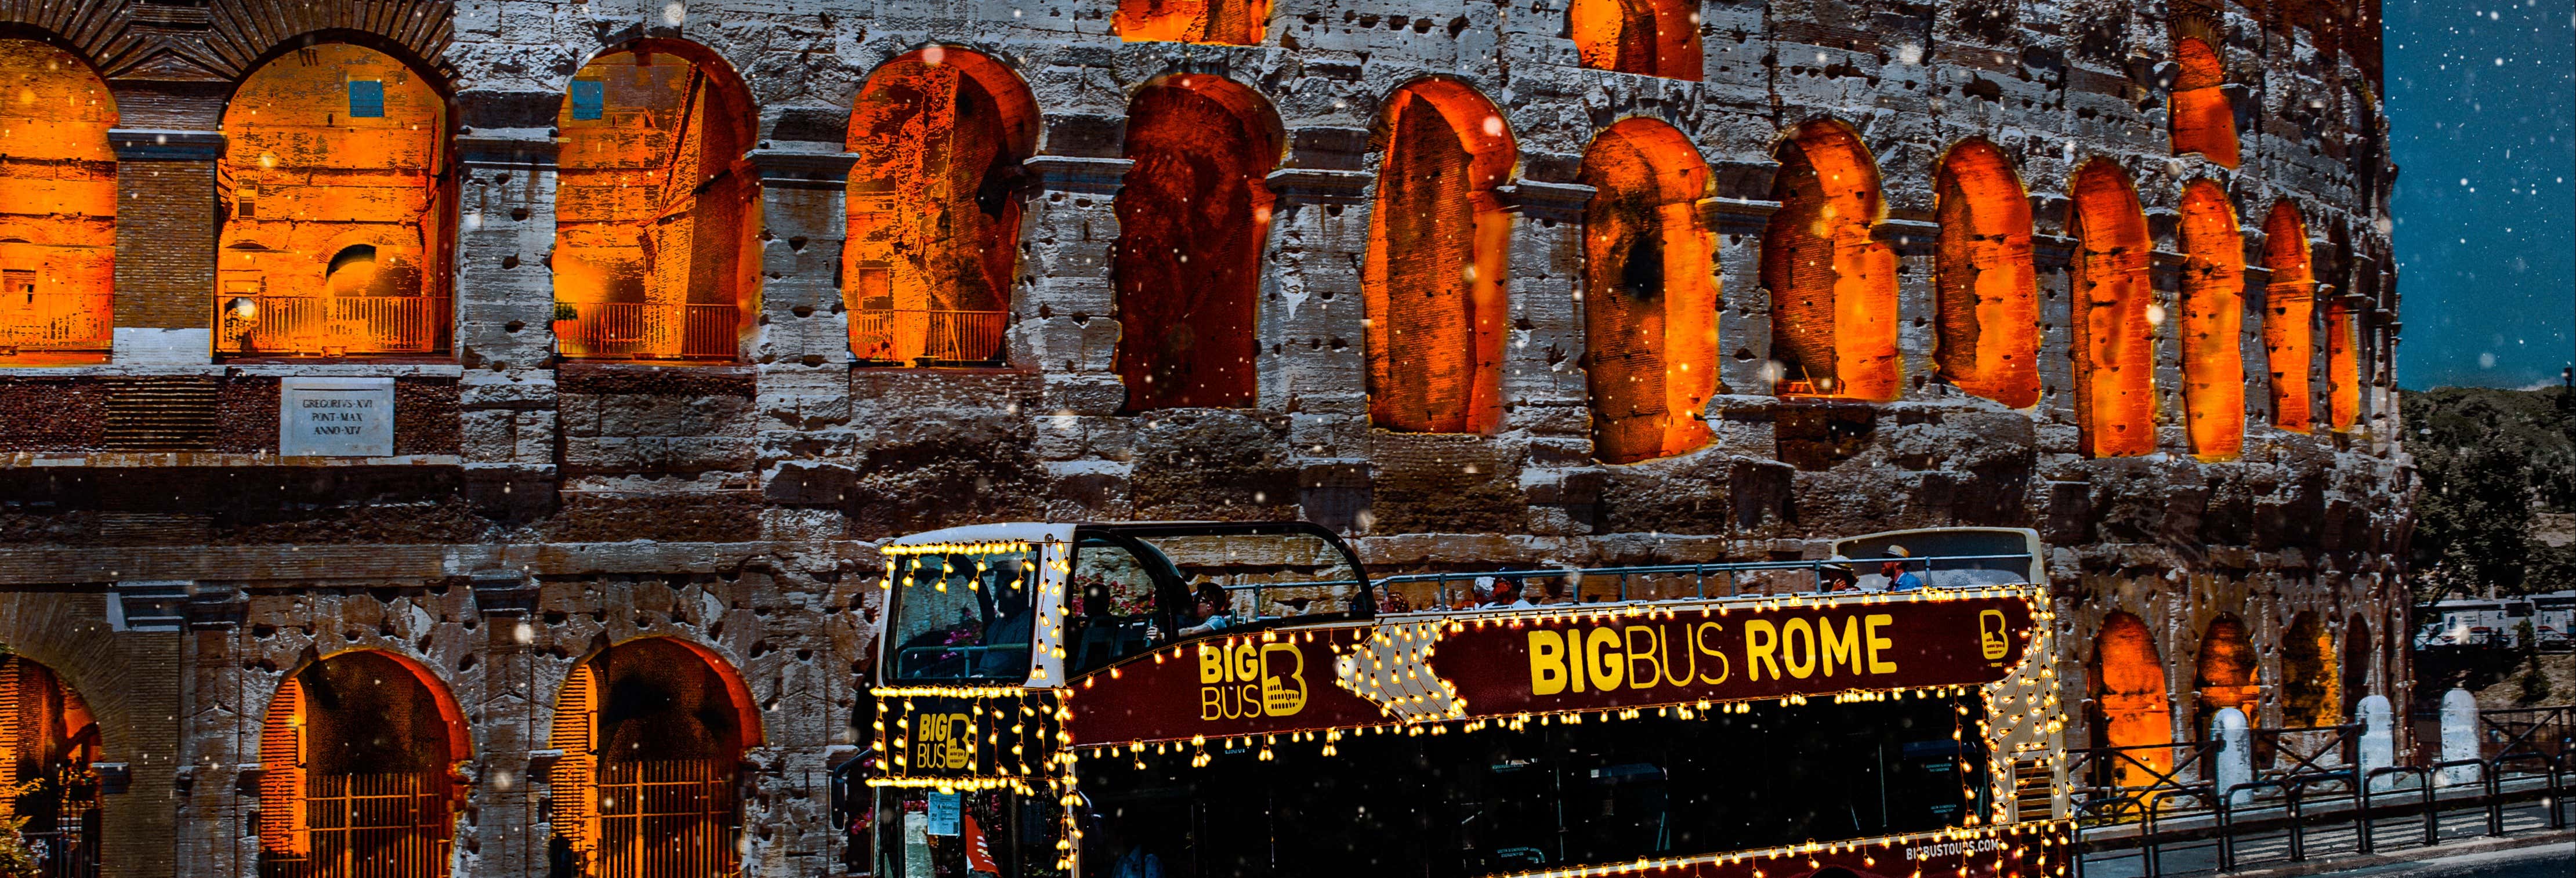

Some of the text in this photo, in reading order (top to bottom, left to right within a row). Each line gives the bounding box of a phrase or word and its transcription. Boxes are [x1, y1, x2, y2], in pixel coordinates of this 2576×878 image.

[1199, 644, 1258, 684] BIG
[1745, 614, 1897, 681] ROME
[1201, 684, 1261, 721] BUS
[919, 713, 947, 741] BIG
[917, 743, 945, 768] BUS
